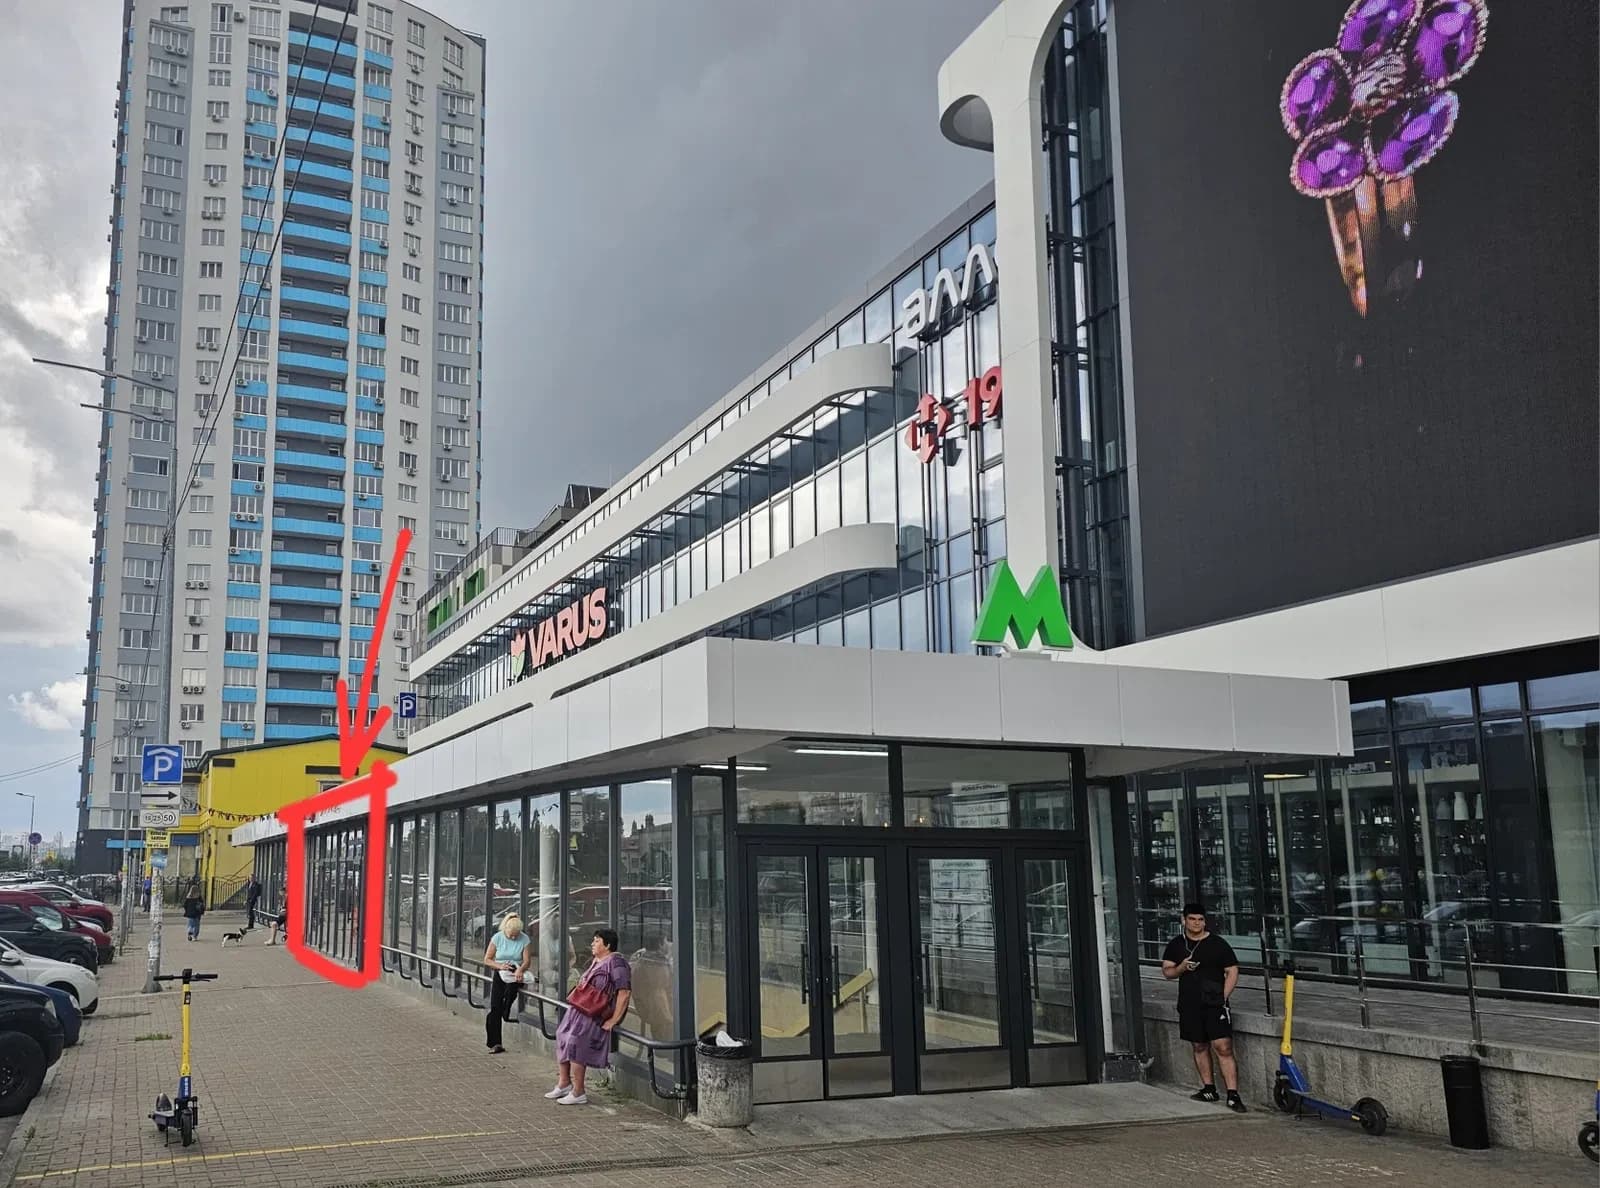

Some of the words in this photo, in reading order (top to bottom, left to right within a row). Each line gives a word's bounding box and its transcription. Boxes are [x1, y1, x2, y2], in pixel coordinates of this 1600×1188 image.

[903, 244, 998, 338] алл
[528, 587, 607, 669] VARUS
[971, 559, 1074, 650] М
[402, 699, 414, 716] P
[153, 756, 173, 781] P
[164, 814, 174, 822] 50
